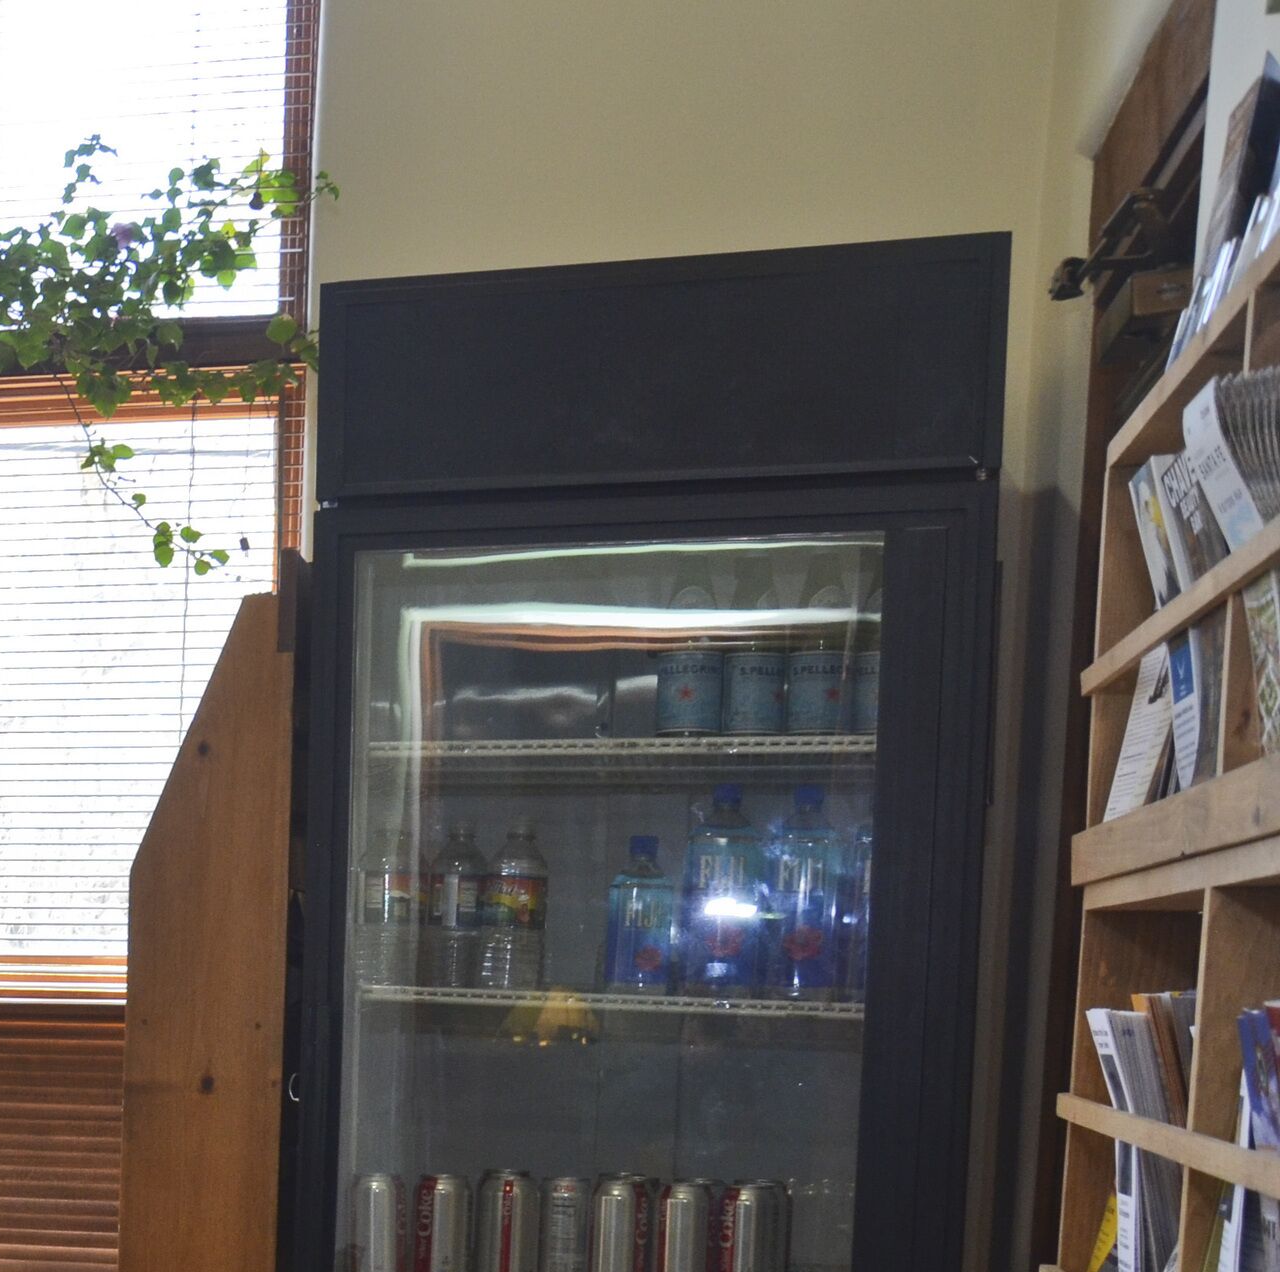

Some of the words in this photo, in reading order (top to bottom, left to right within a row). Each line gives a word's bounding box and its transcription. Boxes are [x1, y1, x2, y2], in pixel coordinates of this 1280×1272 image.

[416, 1188, 433, 1238] Coke
[635, 1197, 649, 1246] Coke
[719, 1199, 736, 1249] Coke
